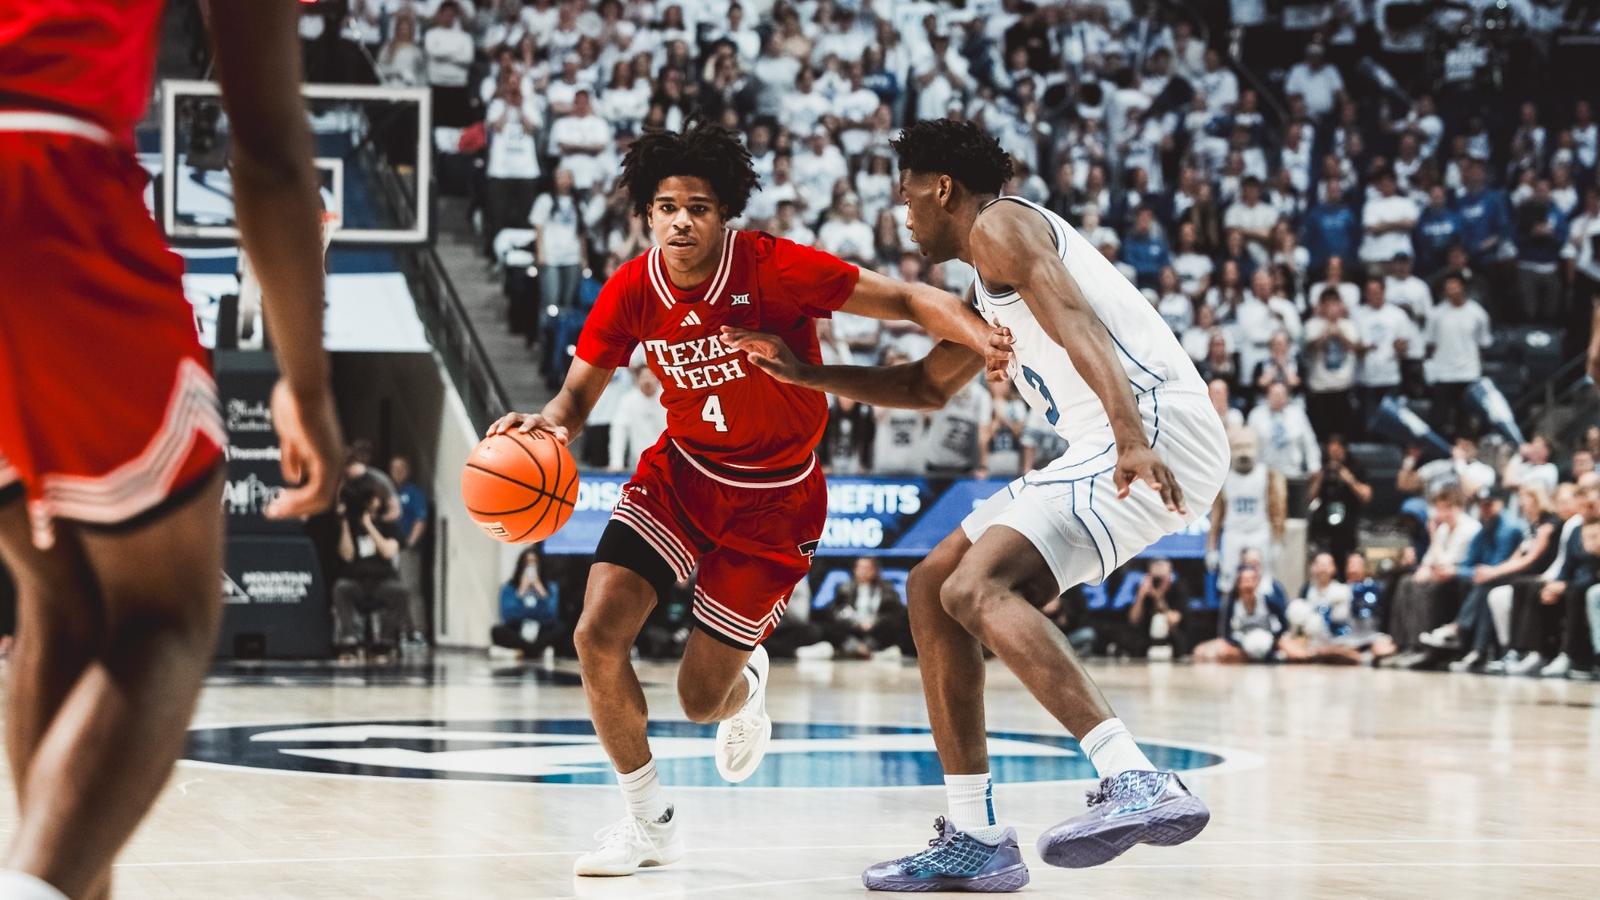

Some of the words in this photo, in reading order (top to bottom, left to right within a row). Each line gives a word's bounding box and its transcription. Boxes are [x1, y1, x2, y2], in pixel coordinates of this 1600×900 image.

[663, 359, 747, 390] TECH
[701, 395, 729, 432] 4
[1021, 364, 1061, 427] 3
